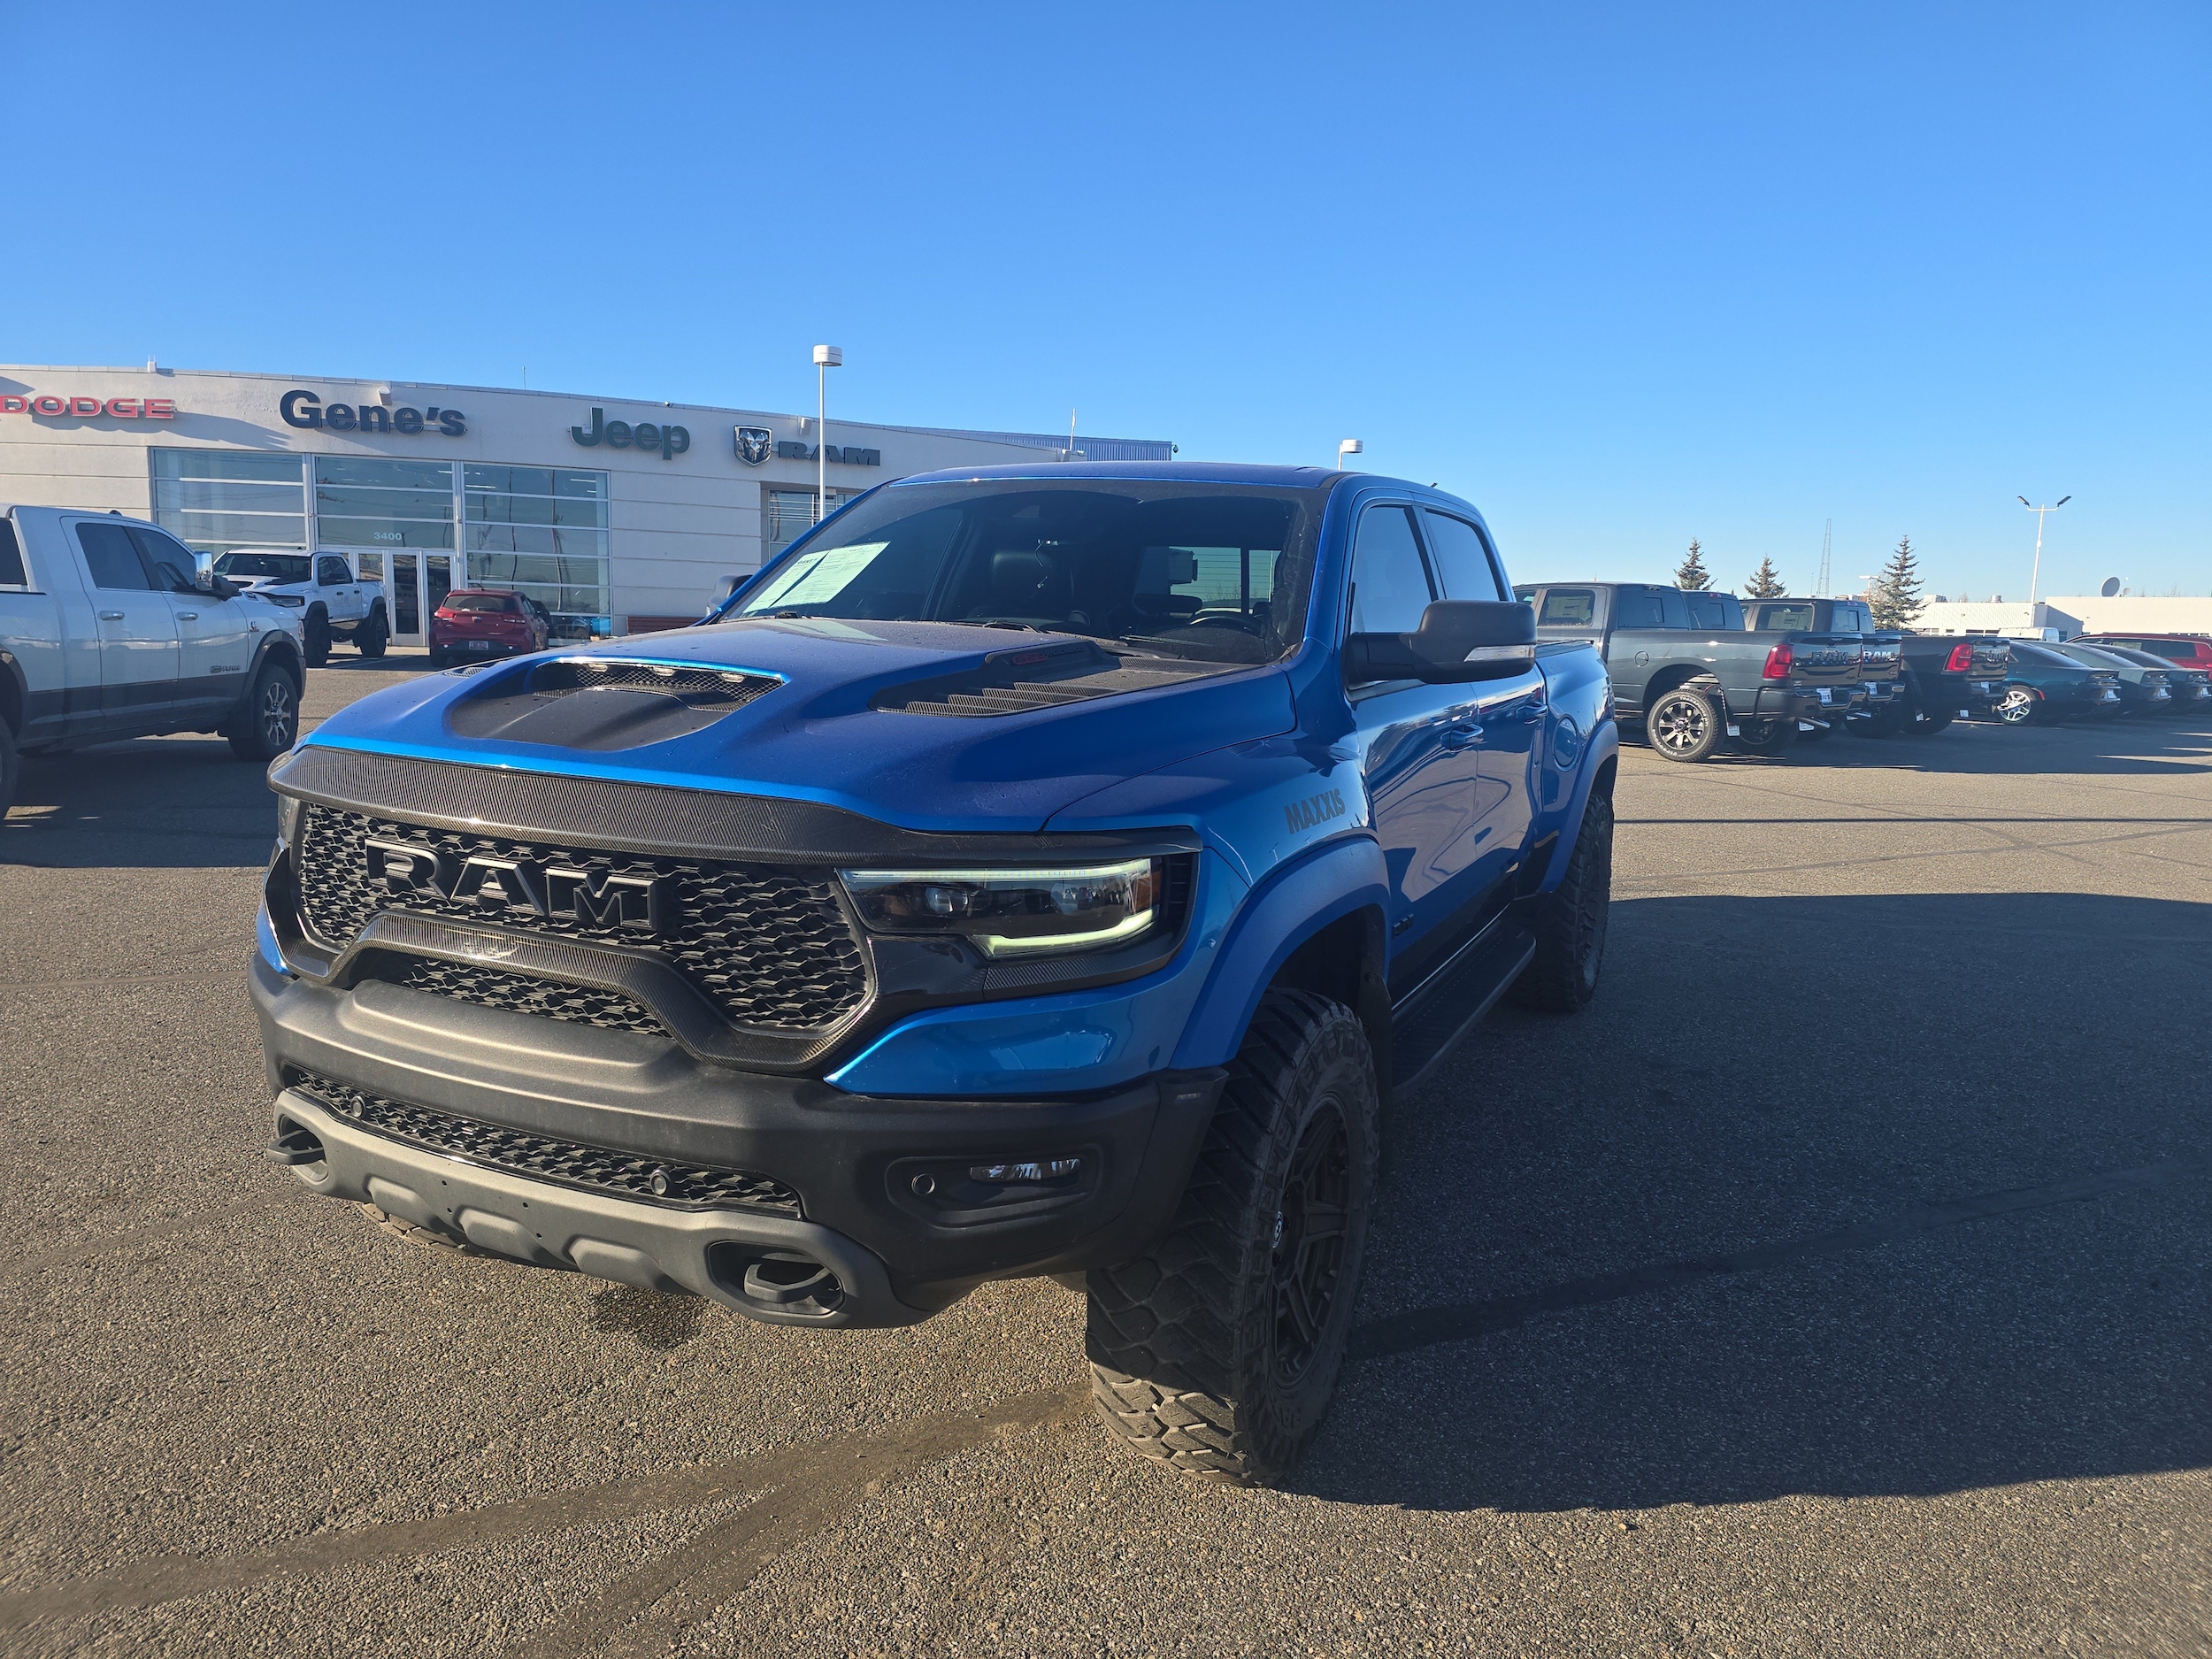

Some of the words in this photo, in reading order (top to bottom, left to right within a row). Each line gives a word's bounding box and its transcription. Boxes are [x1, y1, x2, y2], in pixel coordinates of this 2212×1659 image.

[0, 395, 178, 419] DODGE
[280, 389, 465, 437] Gene's
[570, 407, 690, 460] Jeep
[778, 441, 880, 467] RAM
[373, 532, 403, 541] 3400
[1811, 651, 1849, 662] RAM
[1863, 649, 1892, 660] RAM
[1283, 788, 1346, 835] MAXXIS
[364, 837, 658, 929] RAM
